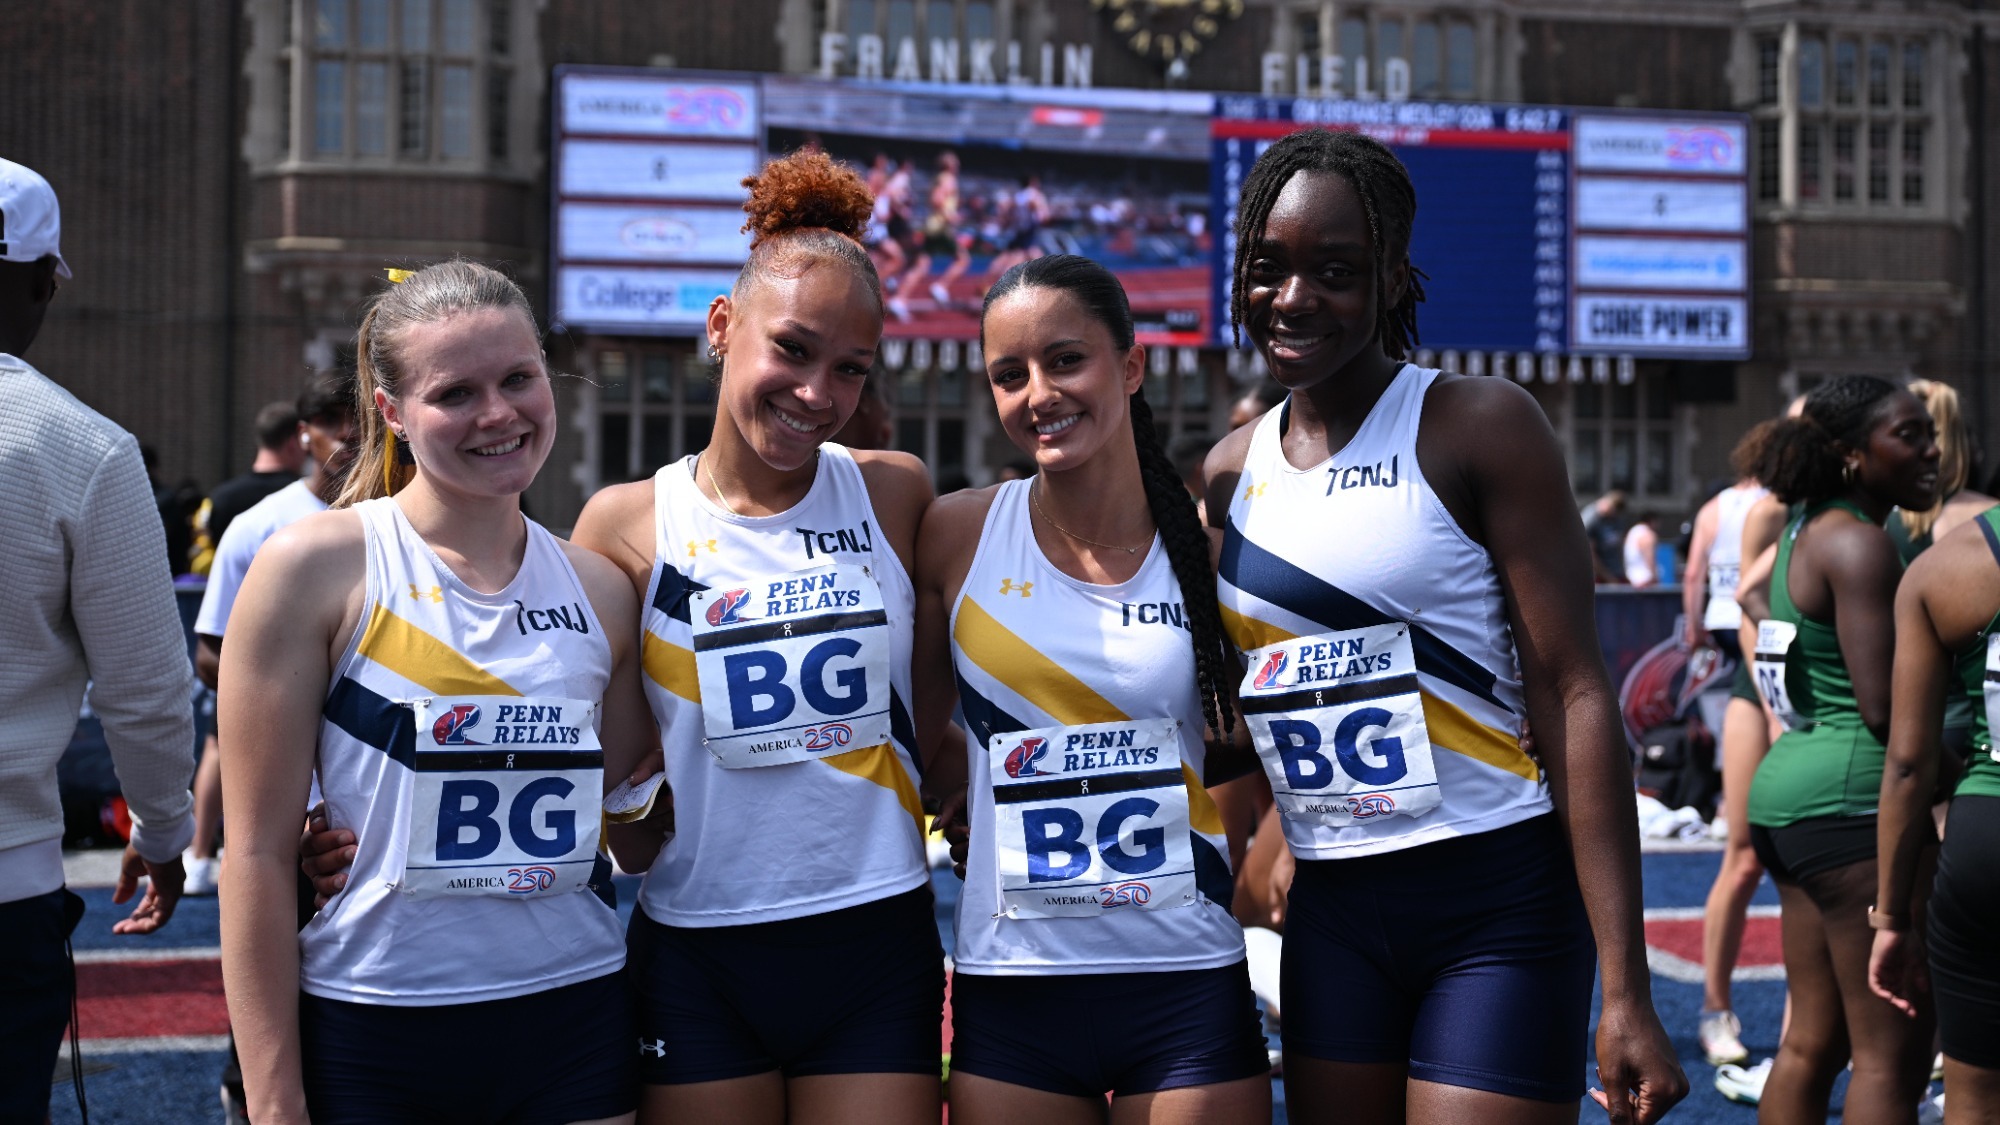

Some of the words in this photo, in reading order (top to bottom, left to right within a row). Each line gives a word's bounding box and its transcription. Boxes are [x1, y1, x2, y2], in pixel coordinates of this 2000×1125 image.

[819, 31, 1094, 88] FRANKLIN
[1260, 52, 1412, 103] FIELD
[579, 274, 676, 317] College
[1588, 303, 1645, 338] CORE
[1651, 305, 1733, 341] POWER
[1325, 453, 1399, 497] TCNJ
[796, 520, 872, 560] TCNJ
[766, 572, 838, 599] PENN
[514, 599, 590, 636] TCNJ
[765, 589, 861, 617] RELAYS
[1121, 601, 1193, 633] TCN
[1297, 637, 1365, 664] PENN
[723, 637, 868, 730] BG
[1297, 651, 1392, 684] RELAYS
[496, 705, 563, 724] PENN
[492, 725, 580, 745] RELAYS
[748, 738, 803, 754] AMERICA
[804, 723, 853, 752] 250
[1064, 729, 1137, 752] PENN
[1267, 707, 1408, 790] BG
[1062, 746, 1159, 772] RELAYS
[435, 776, 577, 861] BG
[1305, 803, 1350, 814] AMERICA
[1347, 793, 1396, 819] 250
[1022, 797, 1167, 884] BG
[447, 876, 506, 889] AMERICA
[507, 865, 556, 894] 250
[1042, 894, 1099, 906] AMERICA
[1099, 882, 1152, 908] 250
